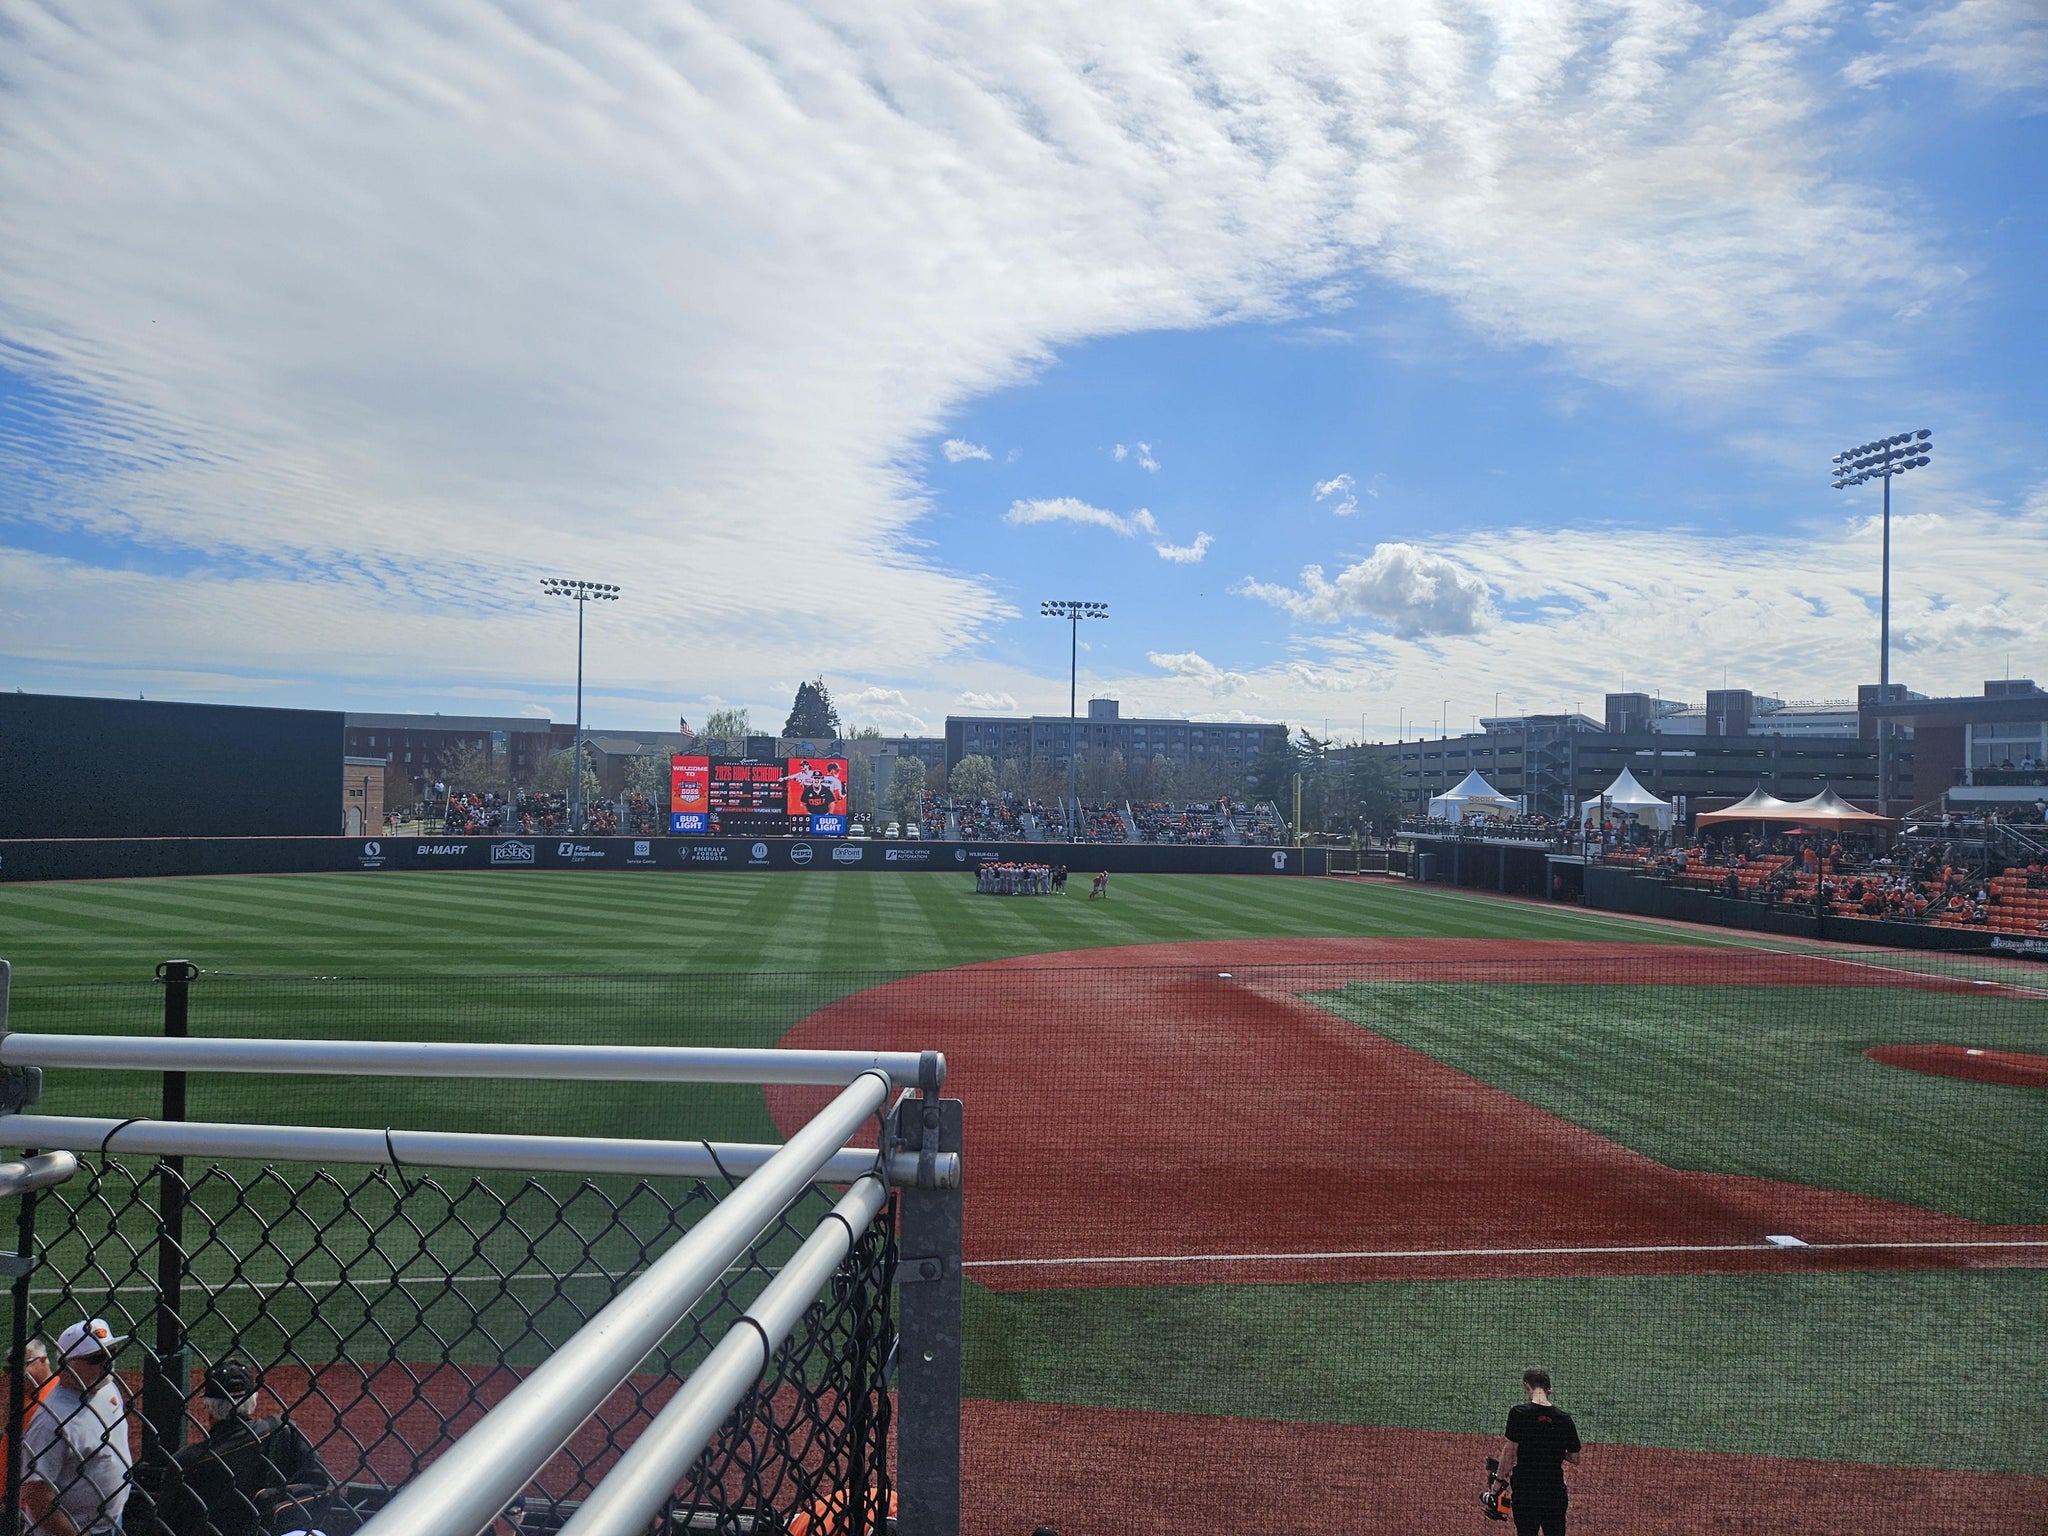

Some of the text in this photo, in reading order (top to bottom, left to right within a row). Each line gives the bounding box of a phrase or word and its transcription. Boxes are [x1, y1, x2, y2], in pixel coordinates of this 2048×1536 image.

[733, 766, 750, 781] HOME
[752, 767, 783, 782] SCHEDULE
[854, 813, 871, 821] 2:52
